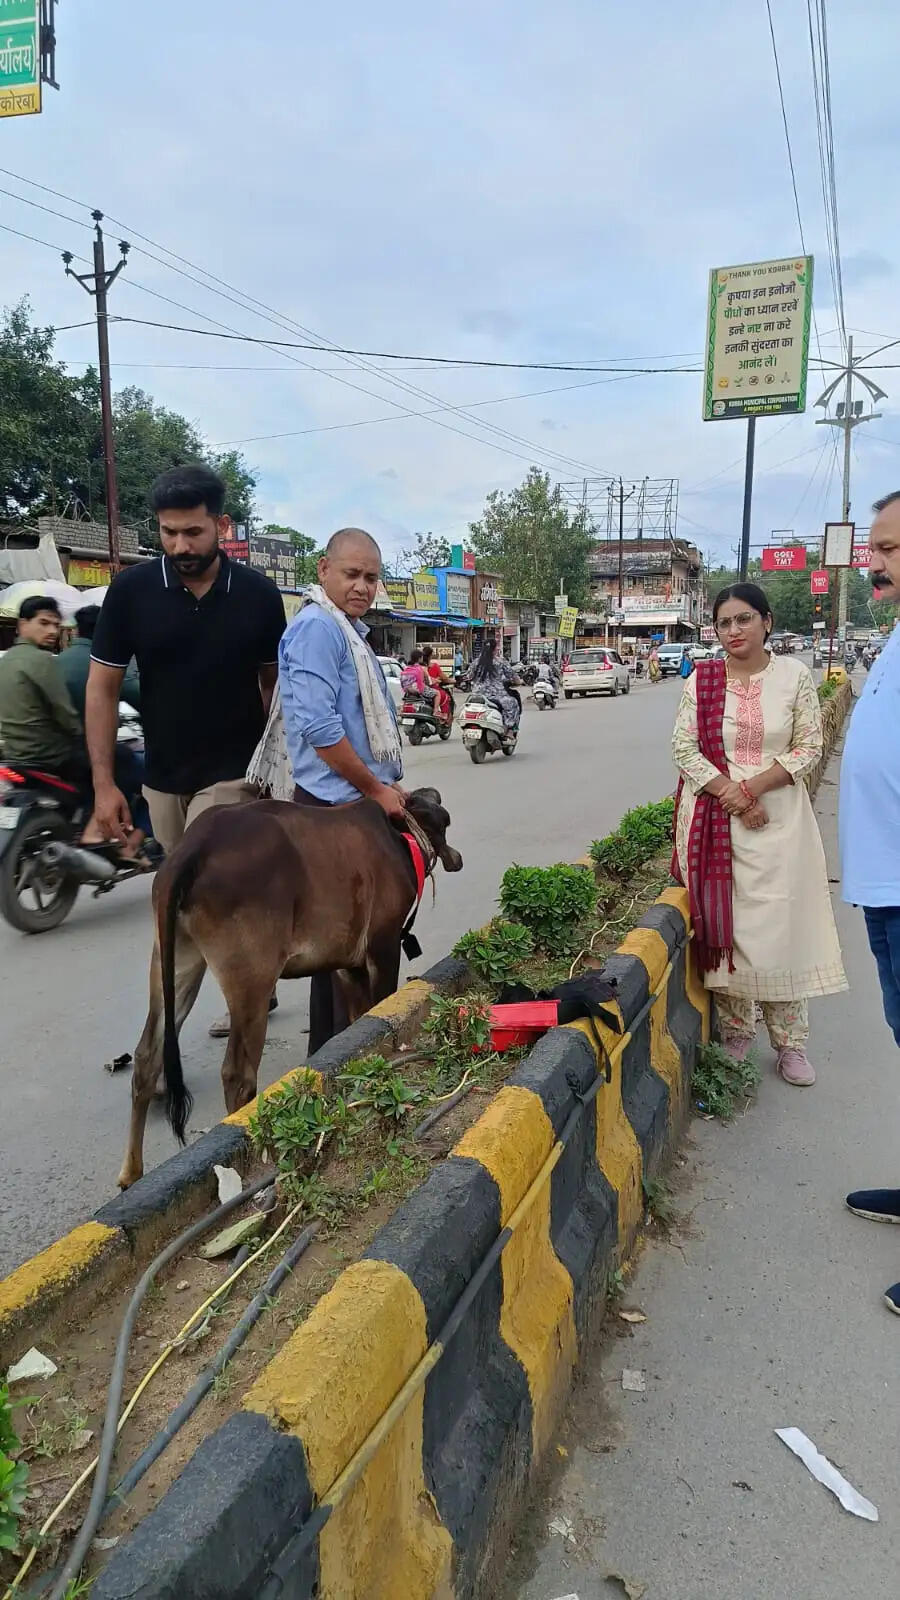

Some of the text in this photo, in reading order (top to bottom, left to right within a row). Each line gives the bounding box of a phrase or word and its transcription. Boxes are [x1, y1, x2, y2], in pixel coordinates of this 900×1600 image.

[729, 270, 751, 279] THANK
[753, 268, 766, 276] YOU
[728, 290, 751, 305] कृपया
[752, 288, 766, 298] इन
[744, 306, 755, 316] का
[757, 303, 779, 314] ध्यान
[763, 321, 775, 331] ना
[725, 337, 794, 354] इनकी सुंदरता का
[738, 356, 763, 369] आनंद
[773, 551, 795, 559] GOEL
